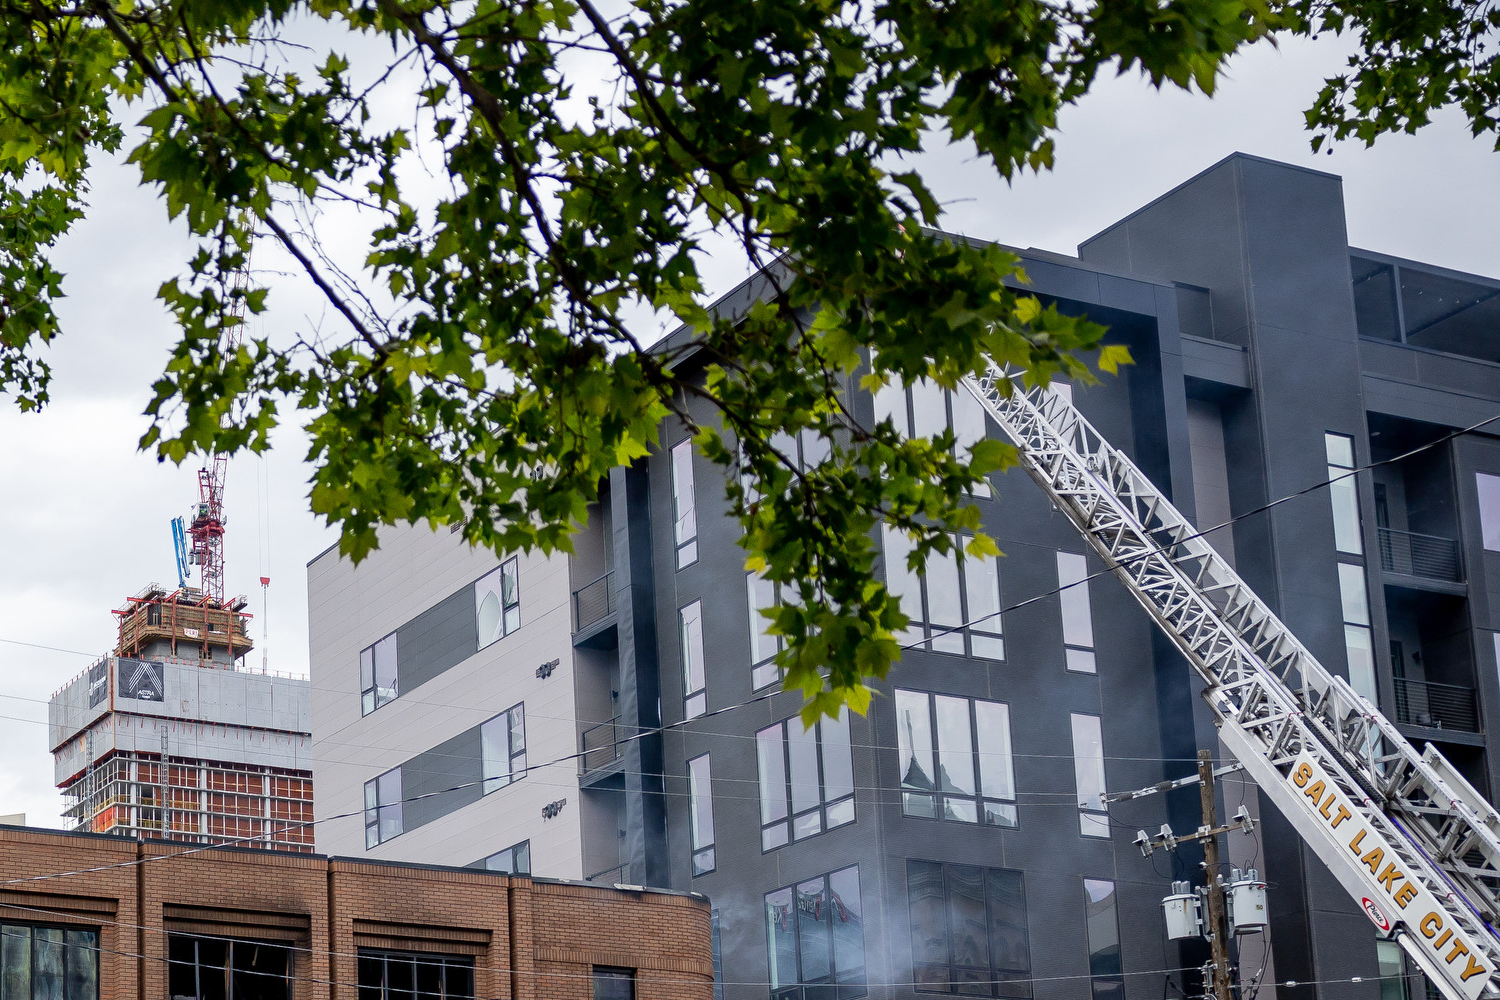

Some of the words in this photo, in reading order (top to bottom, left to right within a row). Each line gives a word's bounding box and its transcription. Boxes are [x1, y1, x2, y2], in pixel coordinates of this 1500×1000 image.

[1293, 762, 1352, 829] SALT
[1349, 828, 1419, 910] LAKE
[1420, 911, 1487, 983] CITY
[1366, 903, 1384, 924] Pierce
